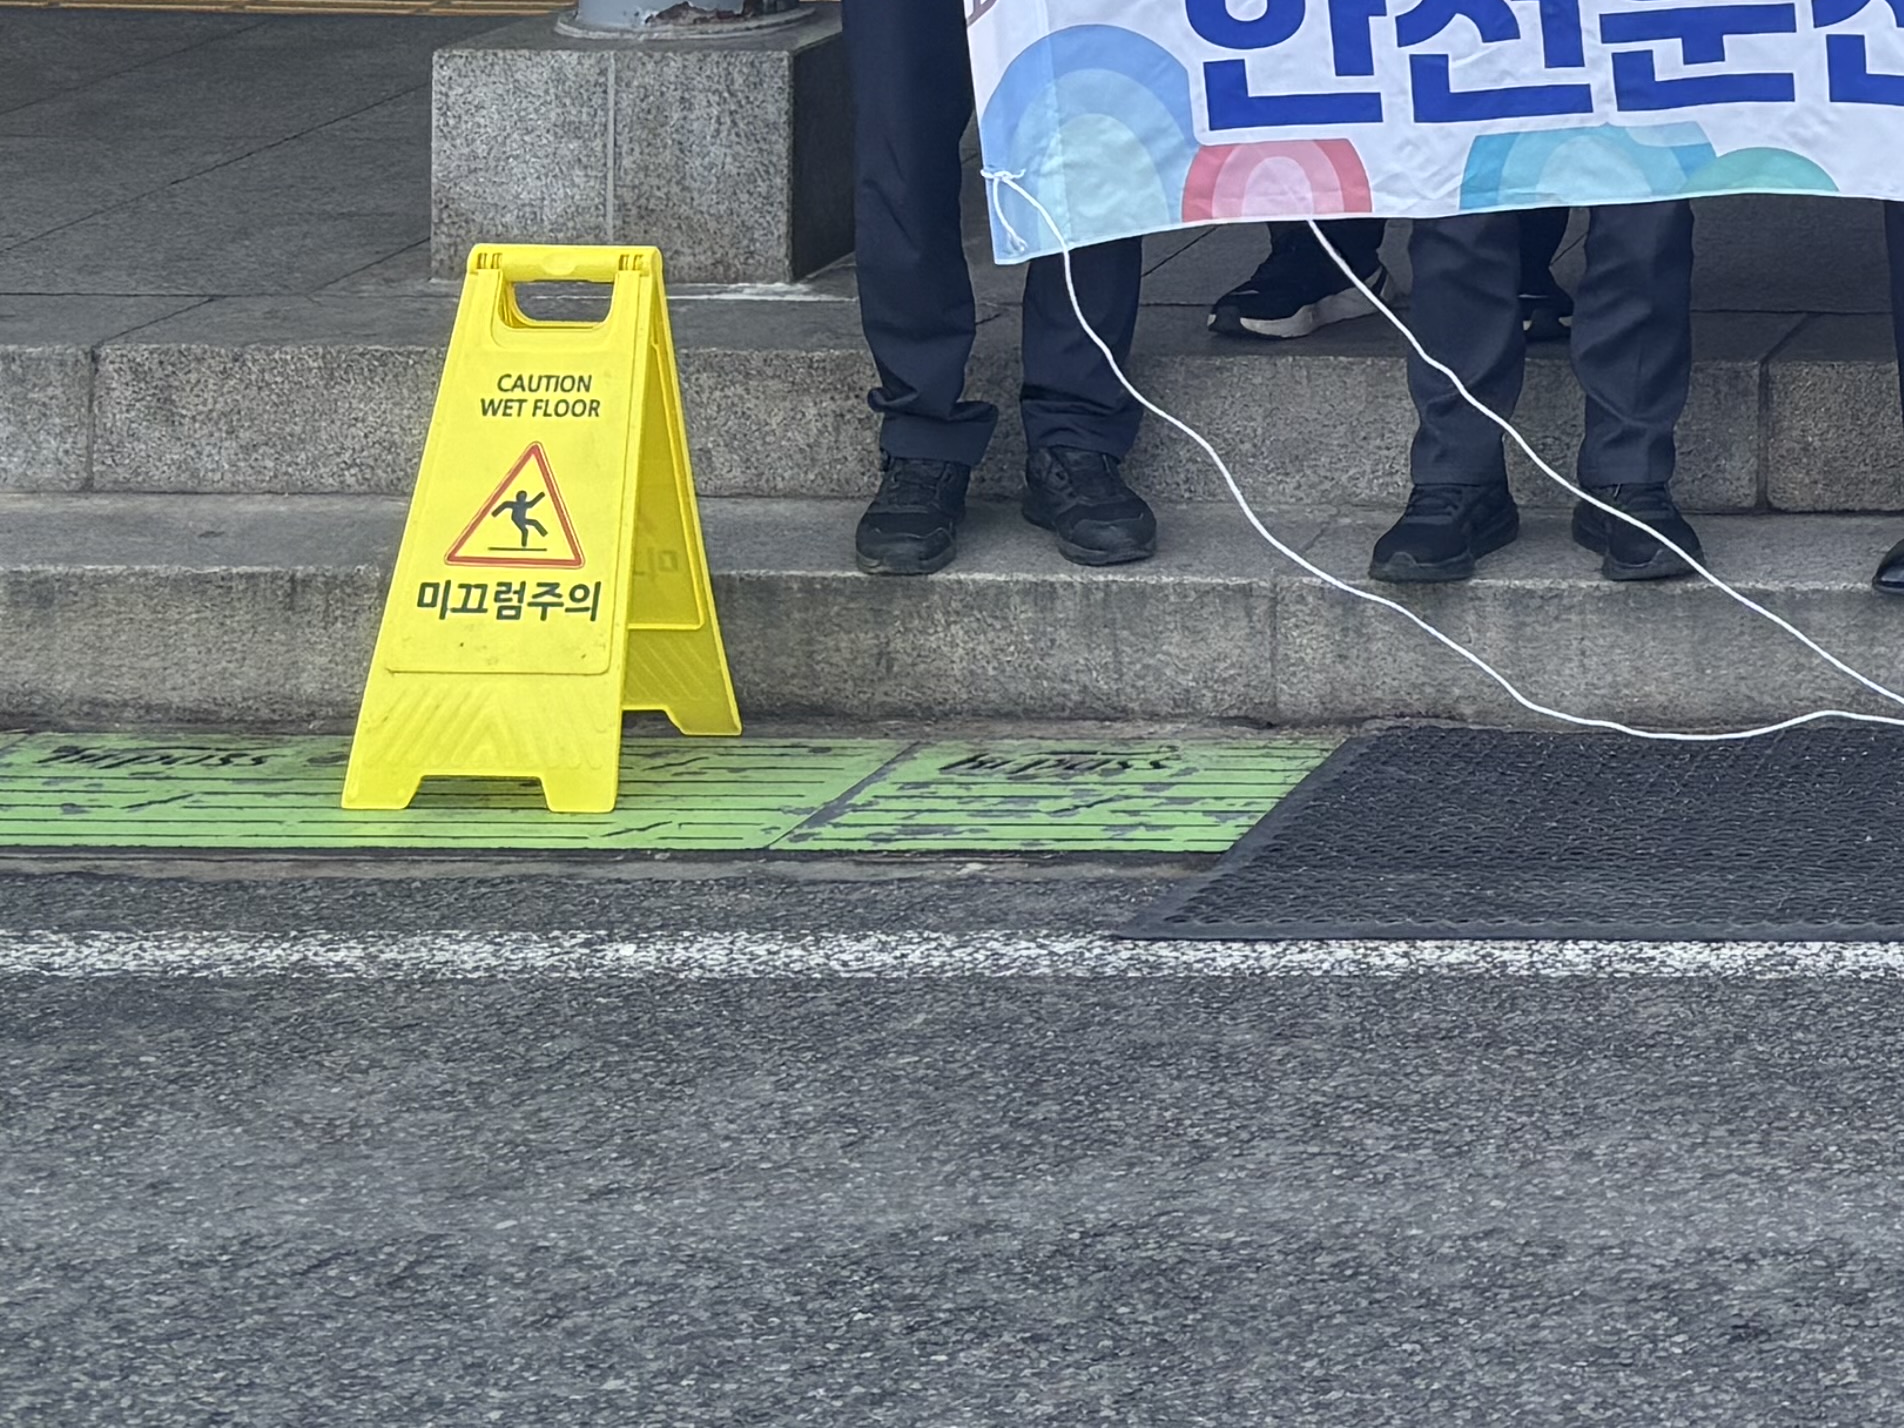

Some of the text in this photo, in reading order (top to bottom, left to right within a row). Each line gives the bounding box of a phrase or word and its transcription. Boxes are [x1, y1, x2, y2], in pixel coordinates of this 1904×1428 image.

[496, 373, 593, 394] CAUTION
[479, 397, 601, 419] WET FLOOR
[416, 580, 601, 622] 미끄럼주의
